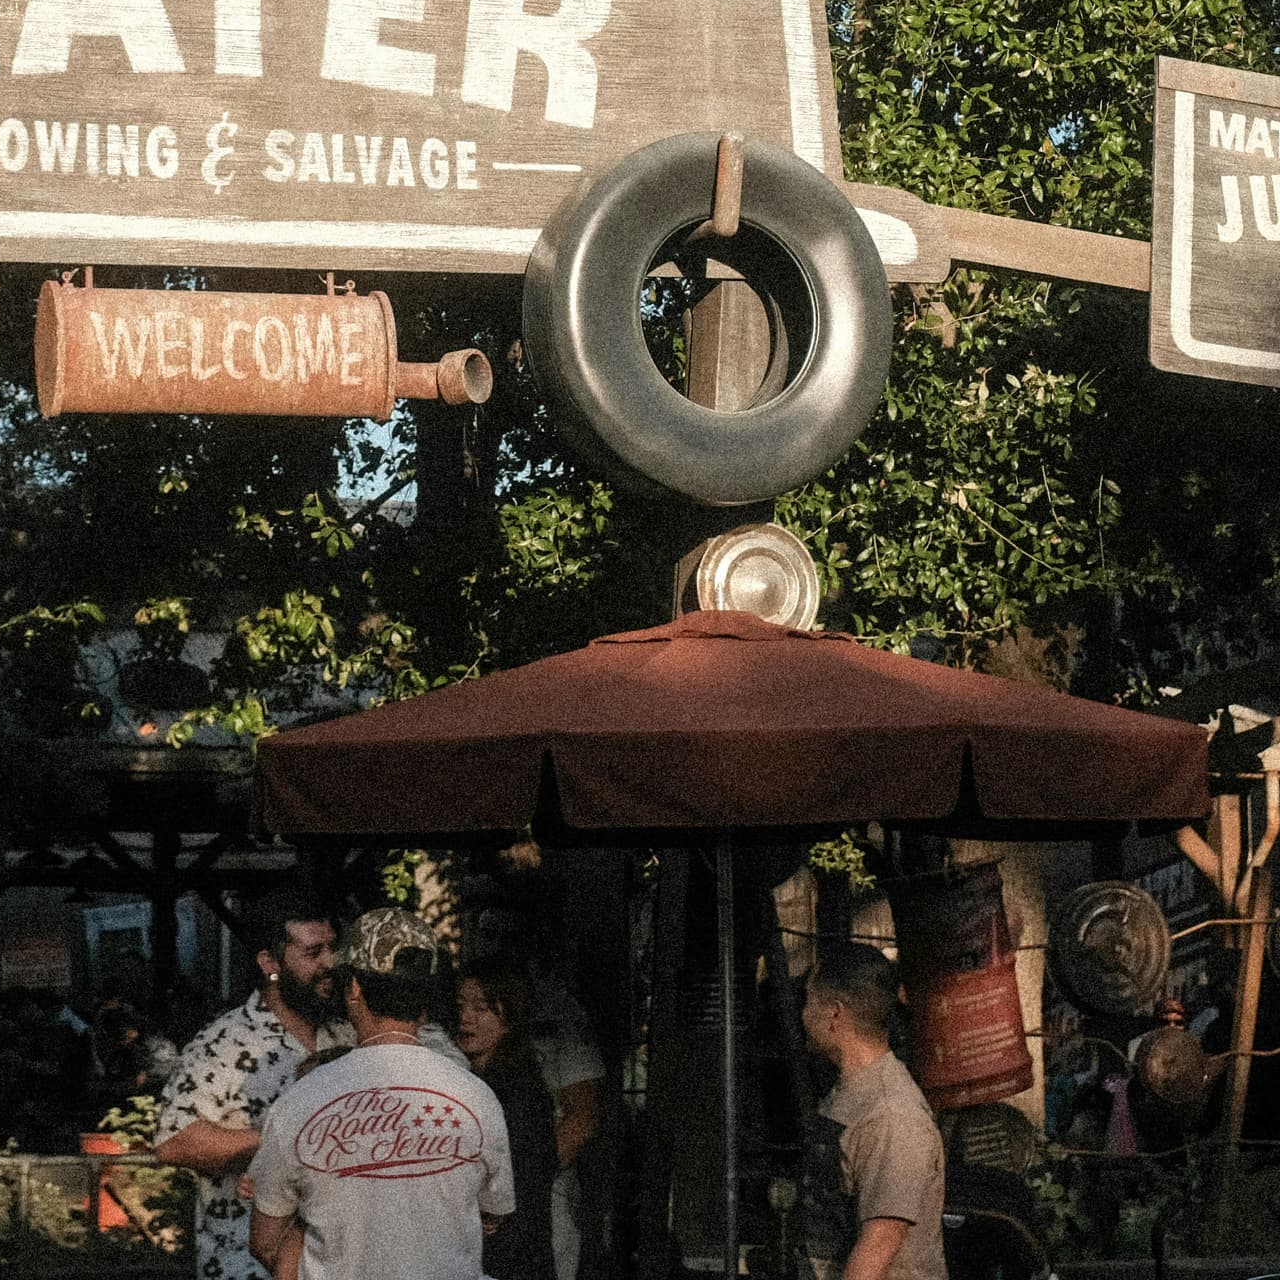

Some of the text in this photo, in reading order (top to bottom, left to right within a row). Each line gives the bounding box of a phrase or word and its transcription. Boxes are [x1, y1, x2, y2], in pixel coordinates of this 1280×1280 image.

[200, 112, 238, 194] &
[263, 128, 479, 190] SALVAGE
[88, 311, 363, 386] WELCOME
[308, 1103, 410, 1157] Road
[345, 1090, 402, 1118] The
[372, 1125, 464, 1162] Series
